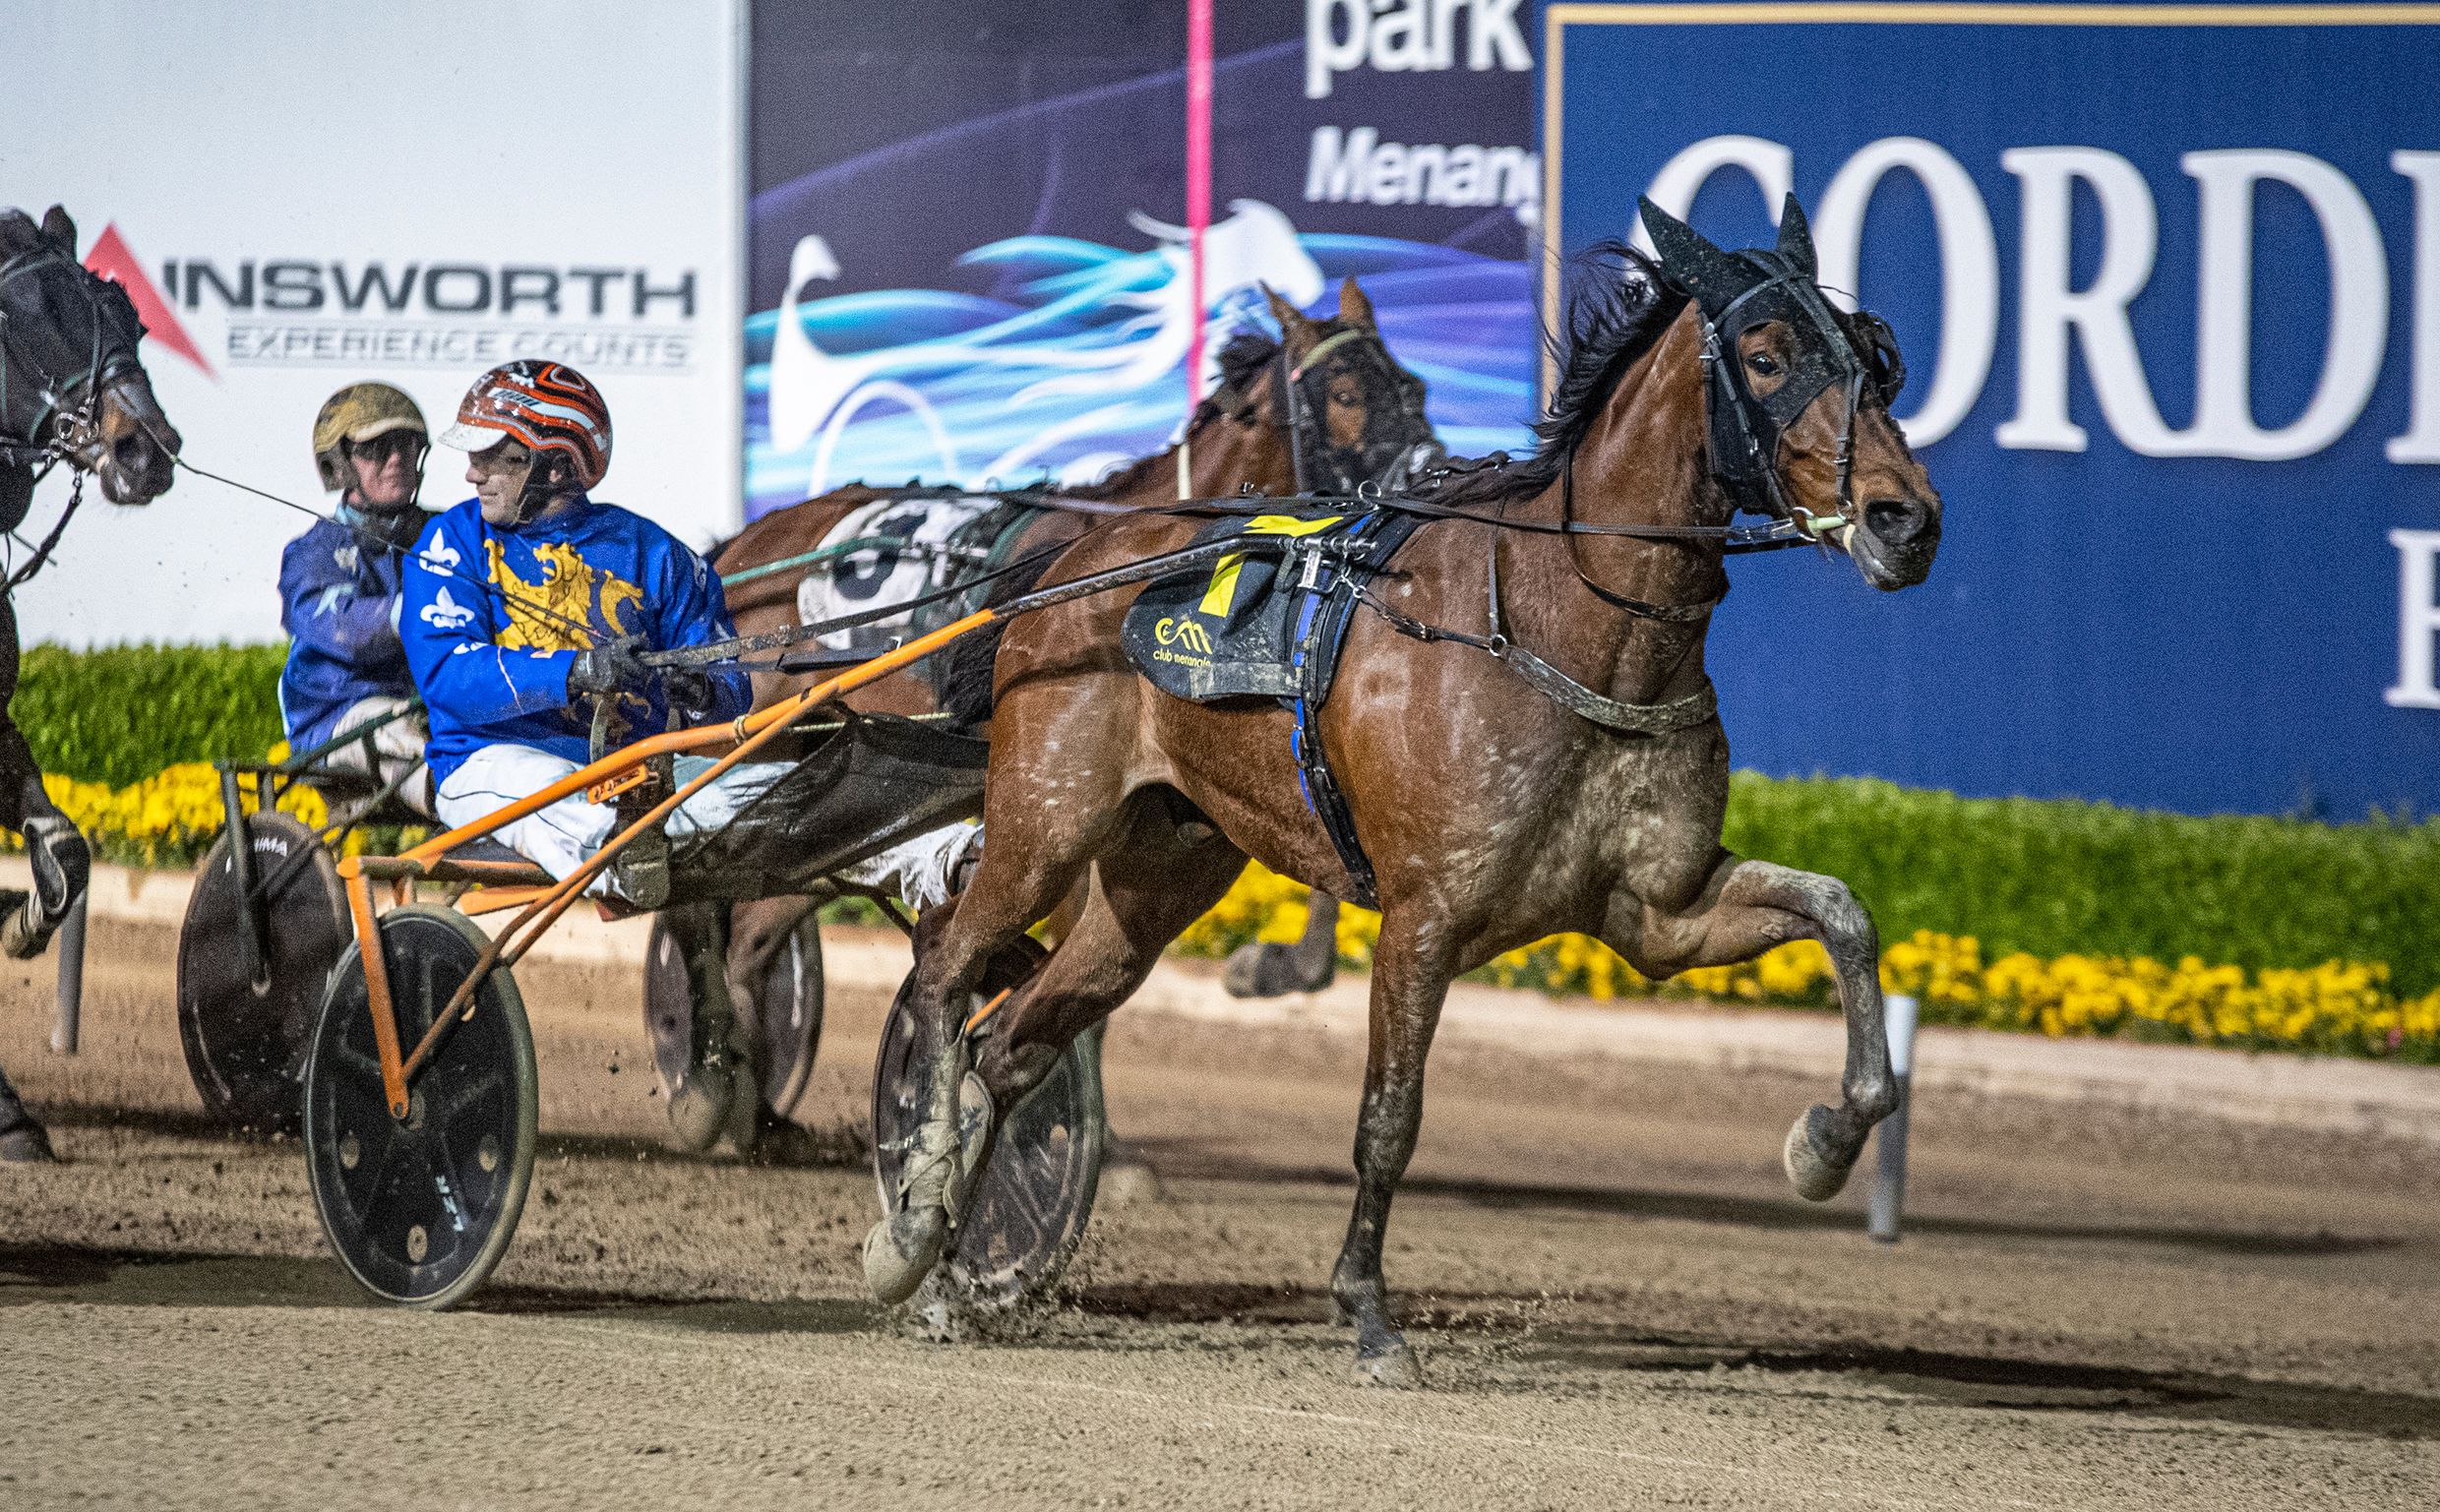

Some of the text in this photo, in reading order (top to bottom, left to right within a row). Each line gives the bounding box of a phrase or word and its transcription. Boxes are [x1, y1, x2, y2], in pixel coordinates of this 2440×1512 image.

[1306, 0, 1533, 98] park
[227, 326, 693, 368] EXPERIENCE COUNTS
[1153, 648, 1173, 663] club
